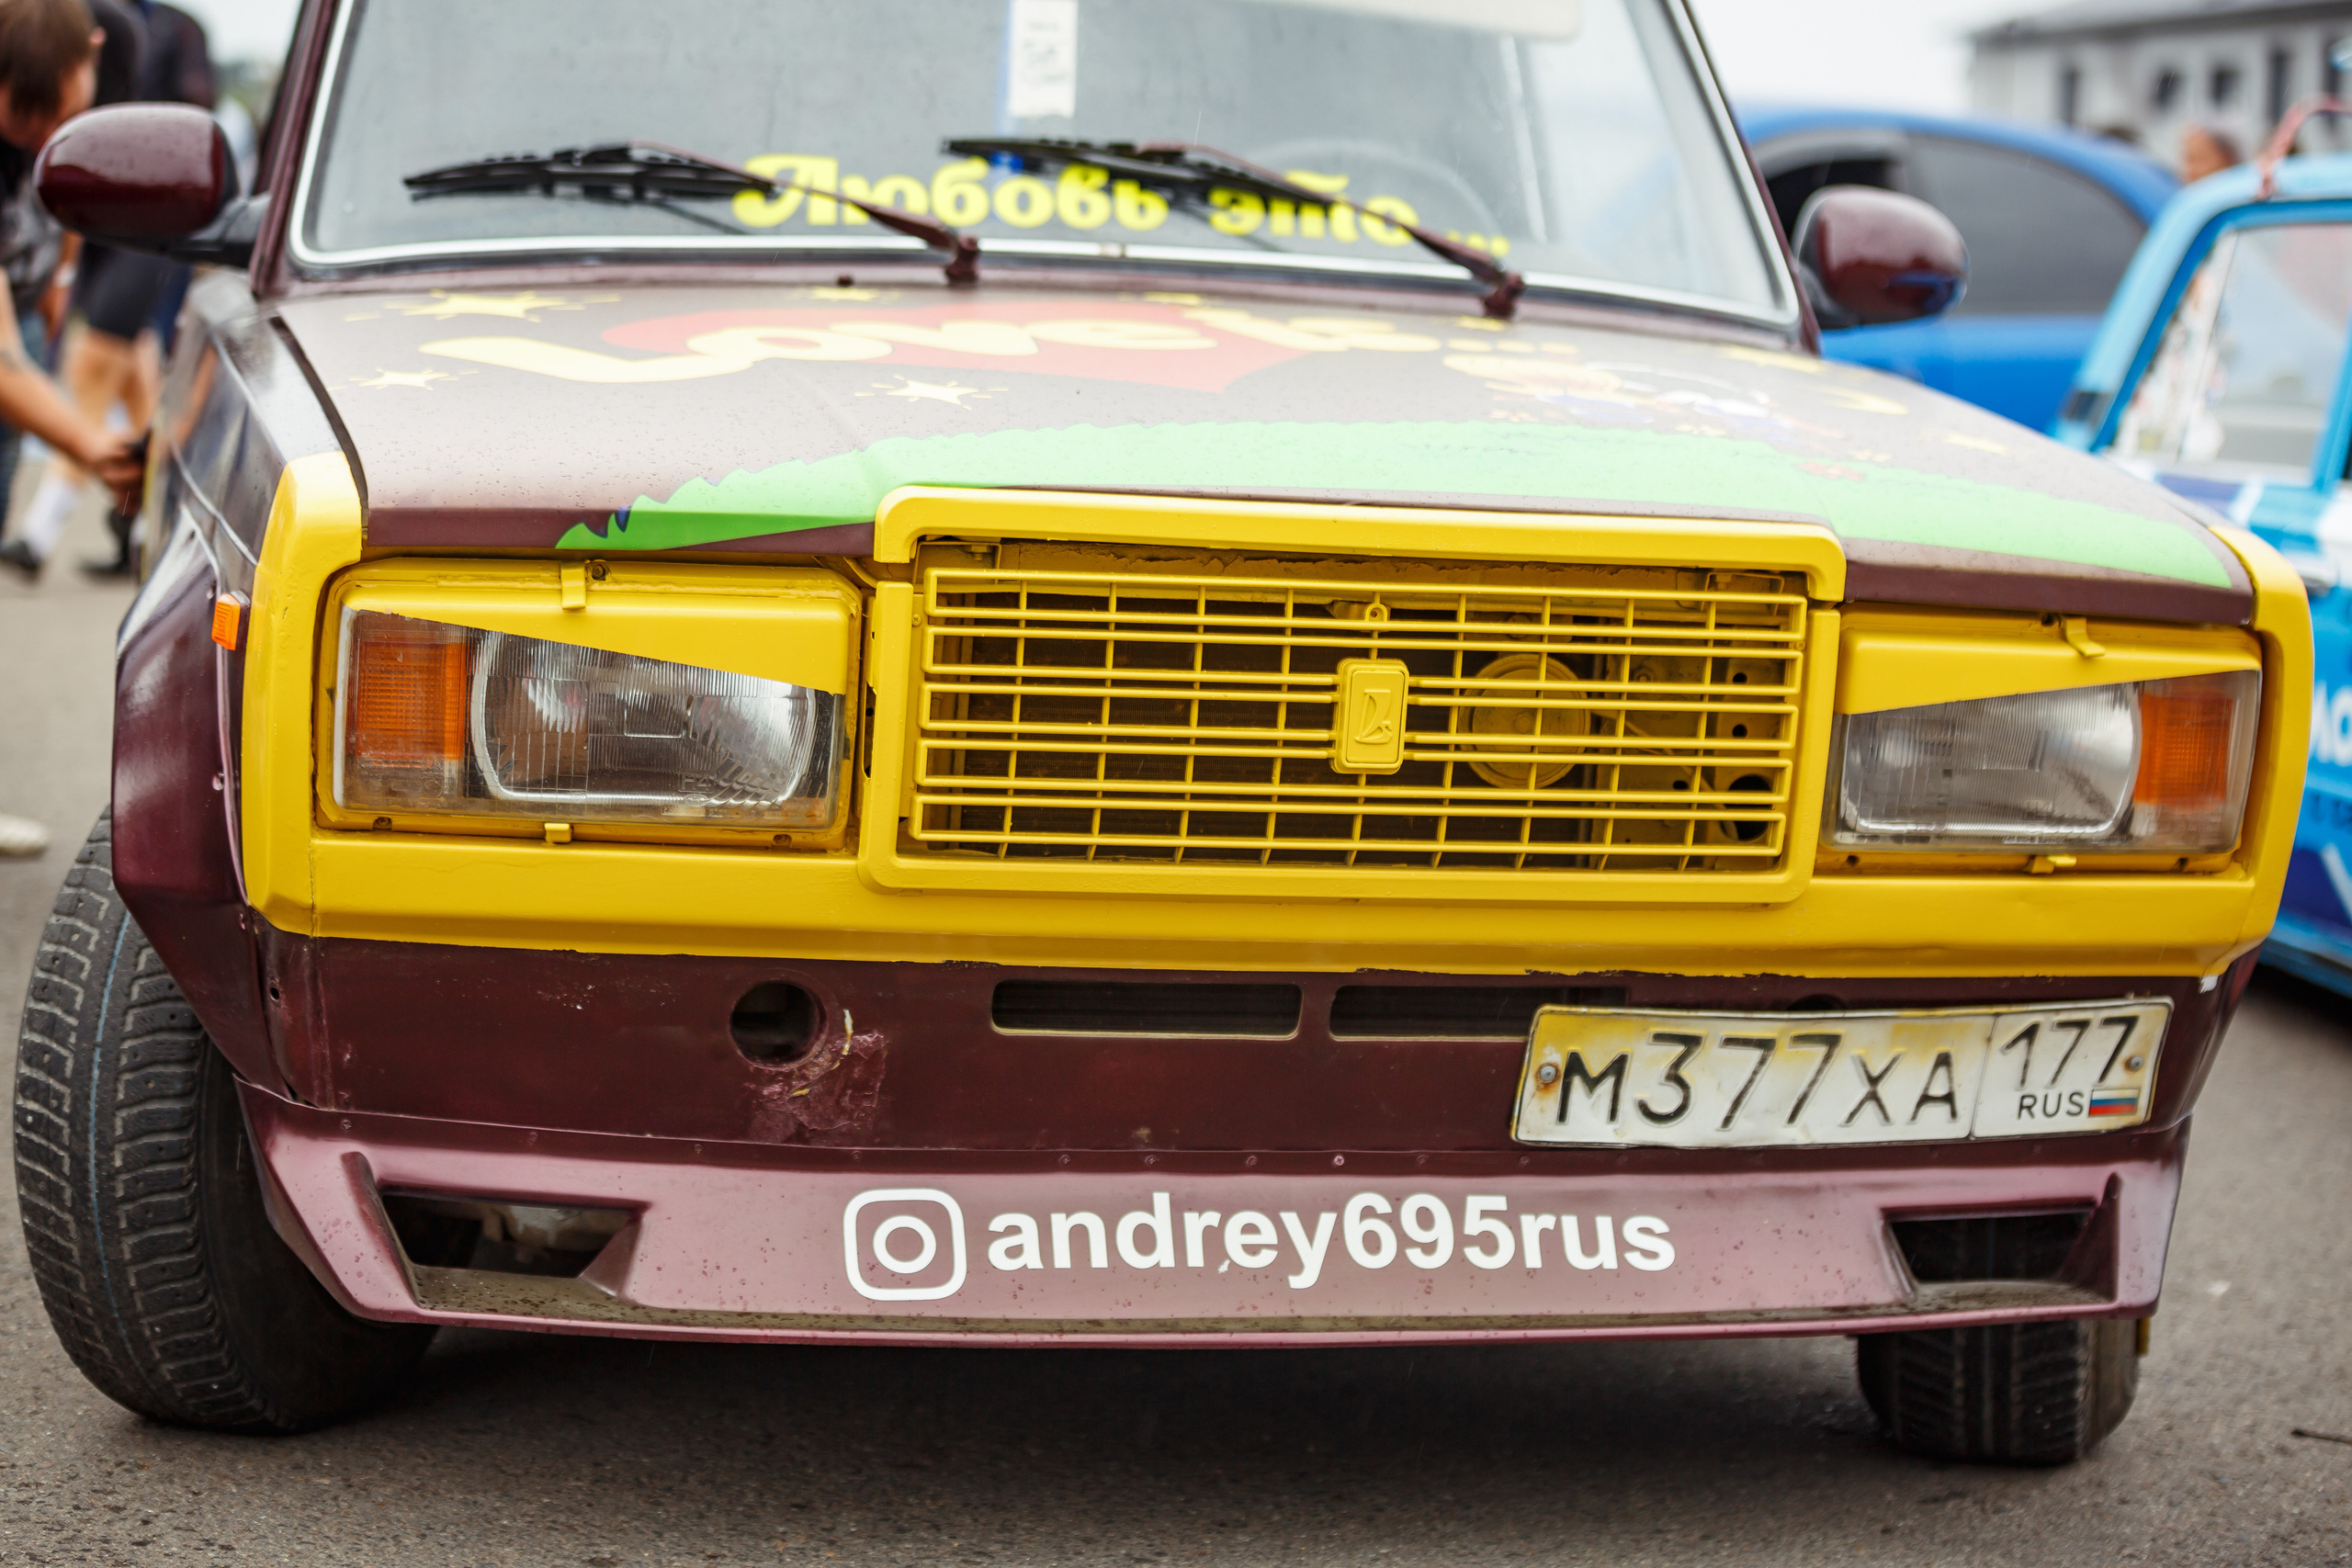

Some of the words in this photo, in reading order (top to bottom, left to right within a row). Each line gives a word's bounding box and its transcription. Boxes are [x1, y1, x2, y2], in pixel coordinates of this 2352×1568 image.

[418, 319, 1217, 384] Love
[2001, 1016, 2141, 1088] 177
[2018, 1089, 2084, 1121] RUS
[987, 1191, 1676, 1289] andrey695rus
